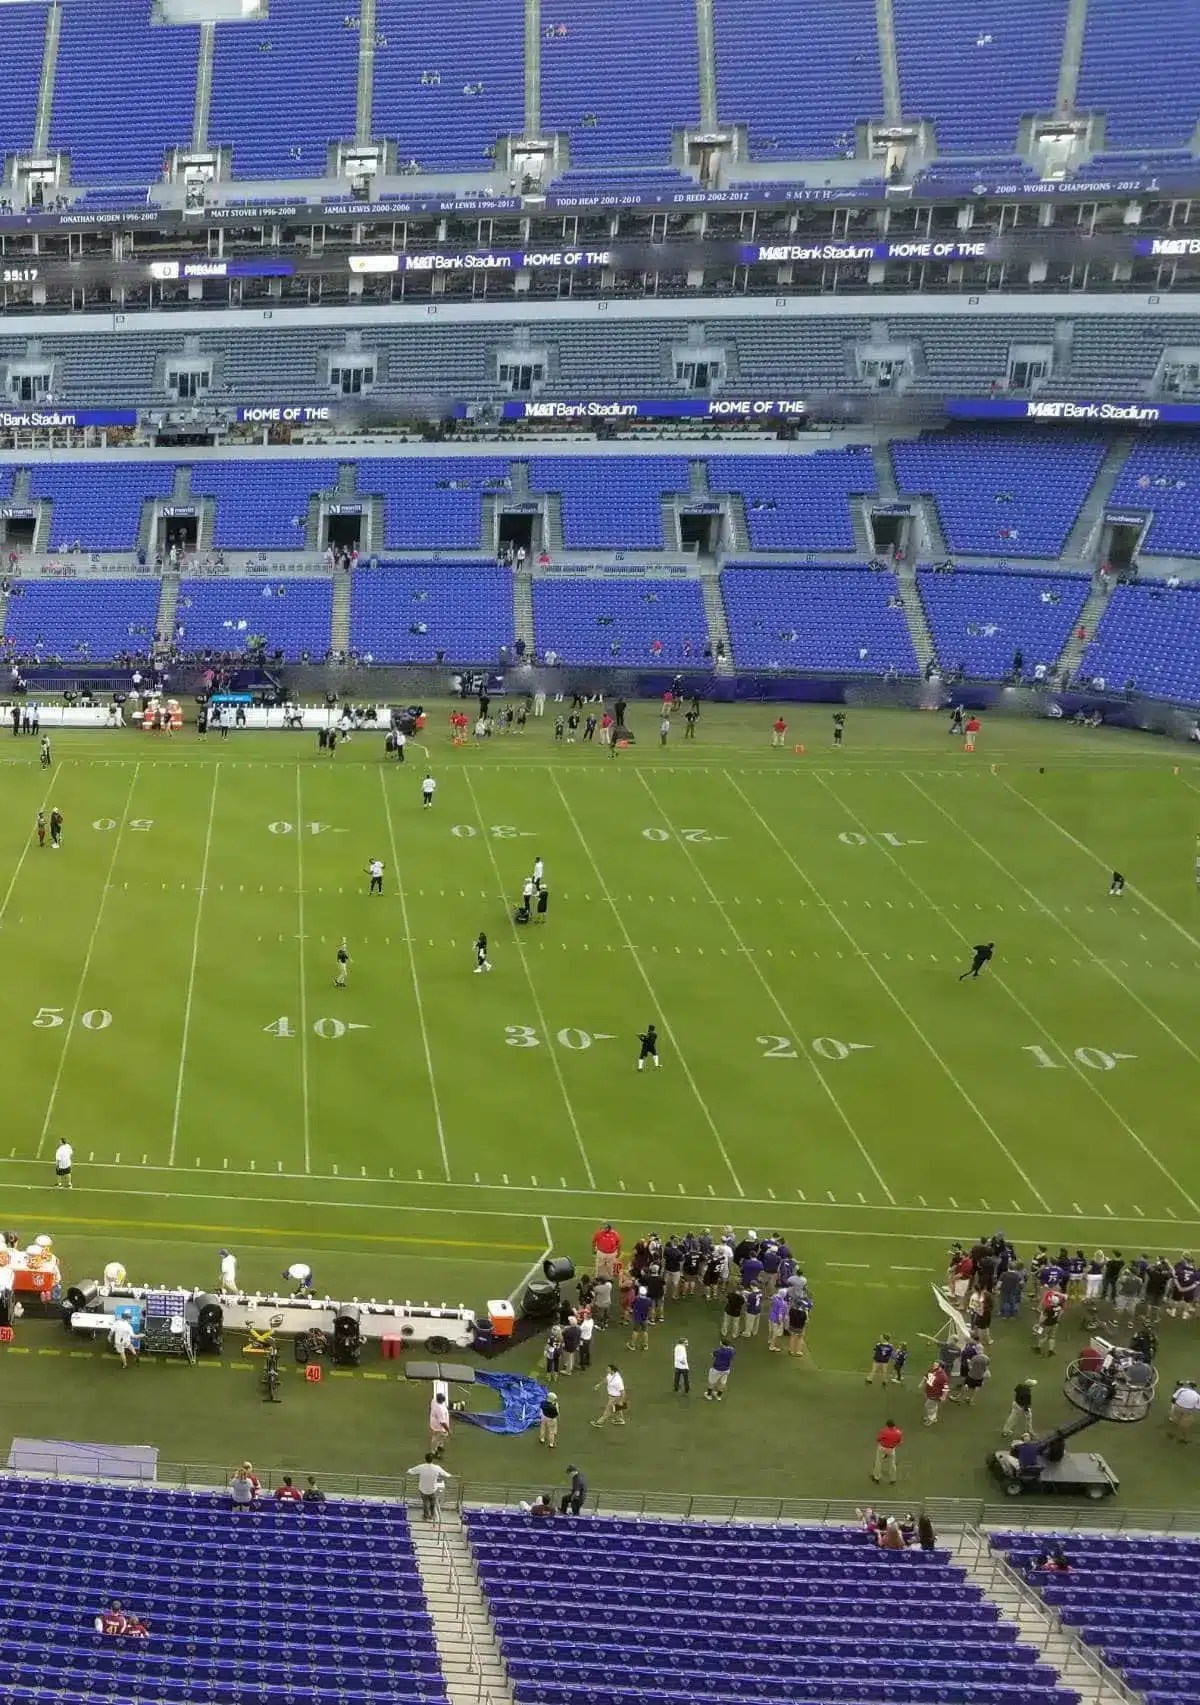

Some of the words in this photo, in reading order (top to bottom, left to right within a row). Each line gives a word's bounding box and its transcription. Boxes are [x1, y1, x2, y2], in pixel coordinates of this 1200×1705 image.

[1024, 184, 1054, 192] WORLD
[1058, 182, 1110, 192] CHAMPIONS
[791, 246, 822, 259] Bank
[823, 246, 874, 258] Stadium
[889, 244, 931, 256] HOME
[933, 244, 954, 256] OF
[957, 243, 985, 255] THE
[436, 255, 463, 269] Bank
[465, 255, 511, 268] Stadium
[523, 254, 561, 266] HOME
[564, 253, 583, 265] OF
[585, 252, 610, 264] THE
[243, 408, 280, 420] HOME
[283, 408, 301, 420] OF
[304, 407, 328, 419] THE
[557, 402, 586, 416] Bank
[587, 402, 637, 416] Stadium
[709, 401, 751, 413] HOME
[753, 401, 774, 413] OF
[777, 401, 805, 412] THE
[1064, 403, 1099, 417] Bank
[1100, 404, 1158, 420] Stadium
[4, 413, 31, 426] Bank
[31, 412, 75, 425] Stadium
[32, 1007, 114, 1030] 50
[262, 1016, 348, 1040] 40
[504, 1024, 592, 1050] 30
[756, 1035, 850, 1060] 20
[1020, 1044, 1116, 1071] 10
[0, 1328, 10, 1340] 50
[308, 1366, 320, 1380] 40
